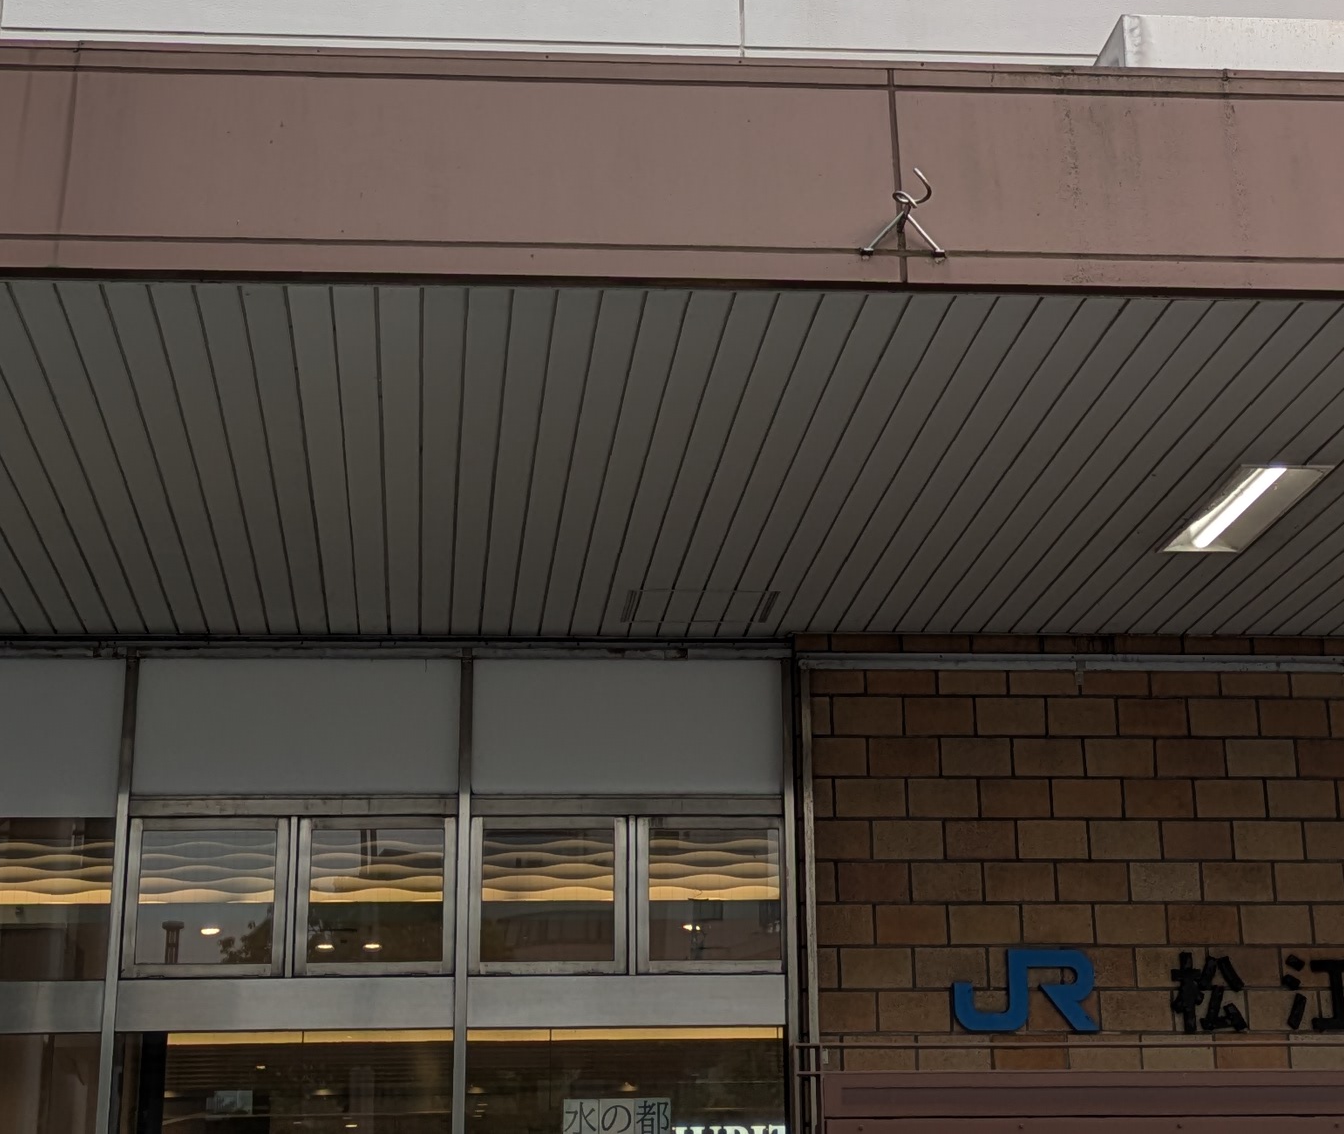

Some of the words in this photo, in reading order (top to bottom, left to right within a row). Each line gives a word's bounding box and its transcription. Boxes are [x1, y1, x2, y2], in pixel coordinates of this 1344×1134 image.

[953, 949, 1100, 1033] JR
[564, 1100, 670, 1134] 水の都
